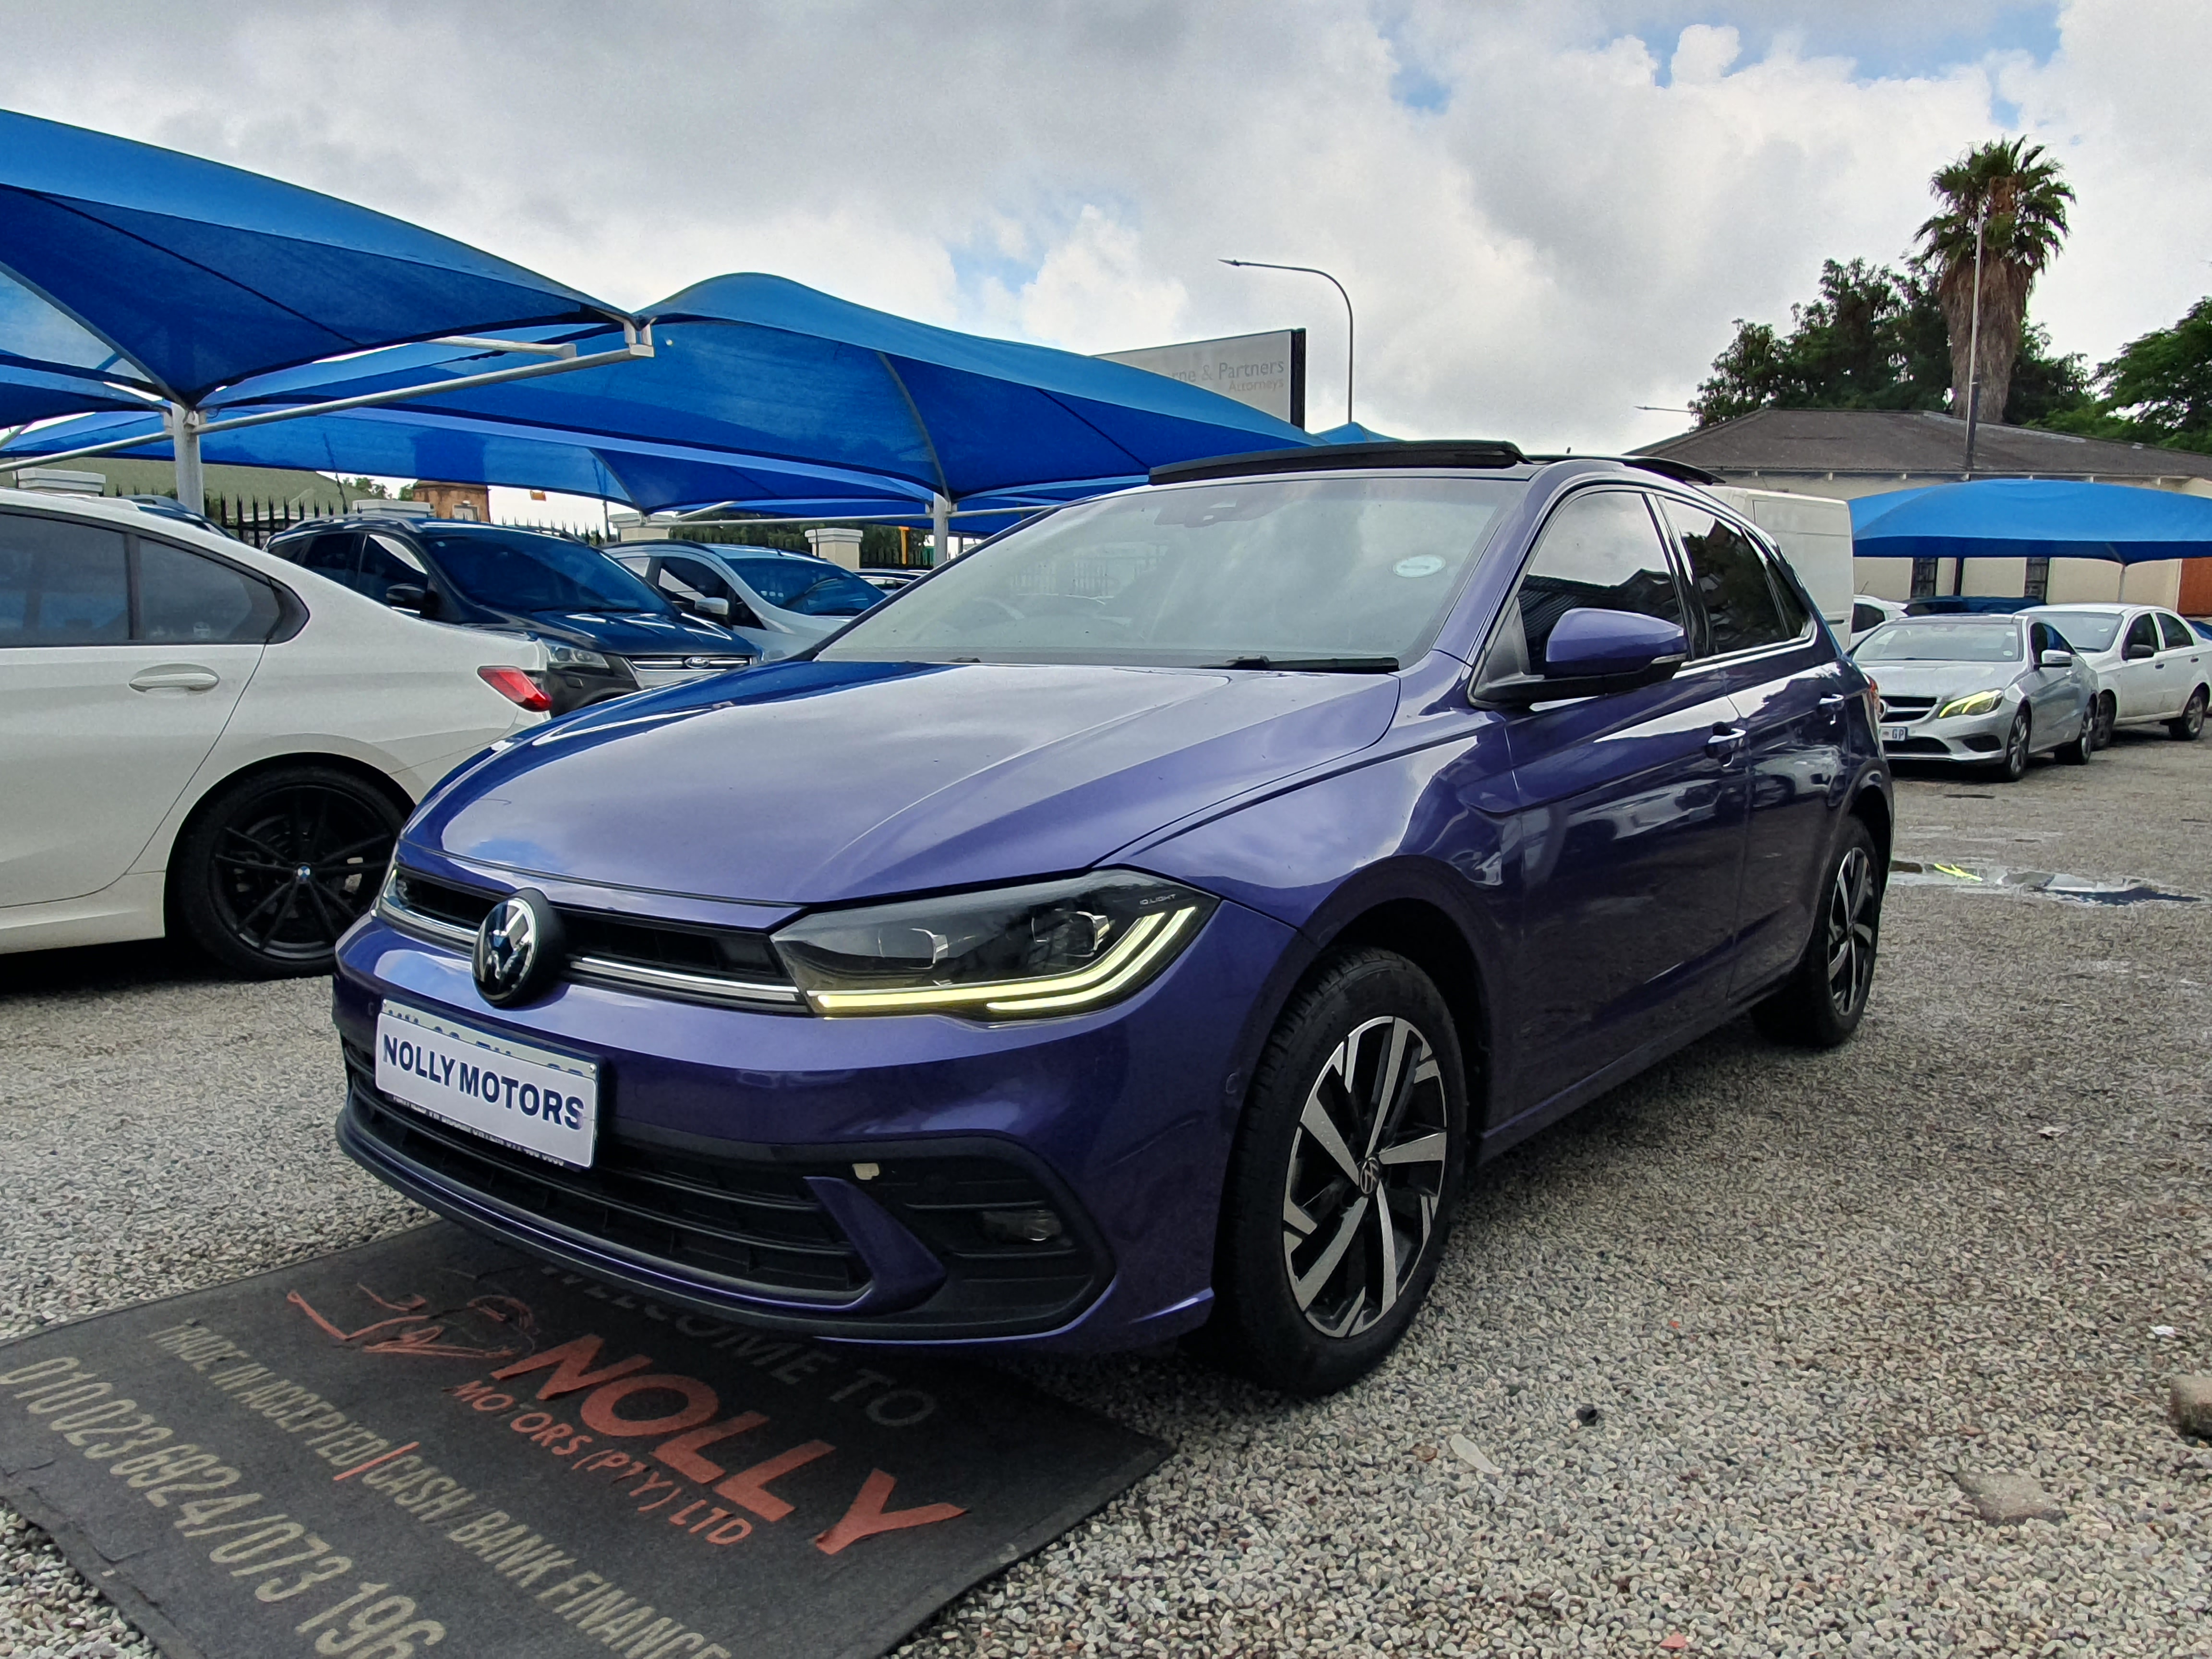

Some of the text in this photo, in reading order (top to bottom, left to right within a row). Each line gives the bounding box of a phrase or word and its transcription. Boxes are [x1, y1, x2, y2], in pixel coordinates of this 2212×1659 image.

[1202, 365, 1214, 381] &
[1219, 361, 1284, 380] Partners
[1228, 379, 1284, 392] Attorneys
[1892, 728, 1904, 739] GP
[383, 1033, 456, 1087] NOLLY
[459, 1062, 584, 1130] MOTORS
[208, 1362, 276, 1391] IN
[490, 1334, 968, 1554] NOLLY
[571, 1448, 681, 1512] (PTY)
[668, 1499, 753, 1545] LTD
